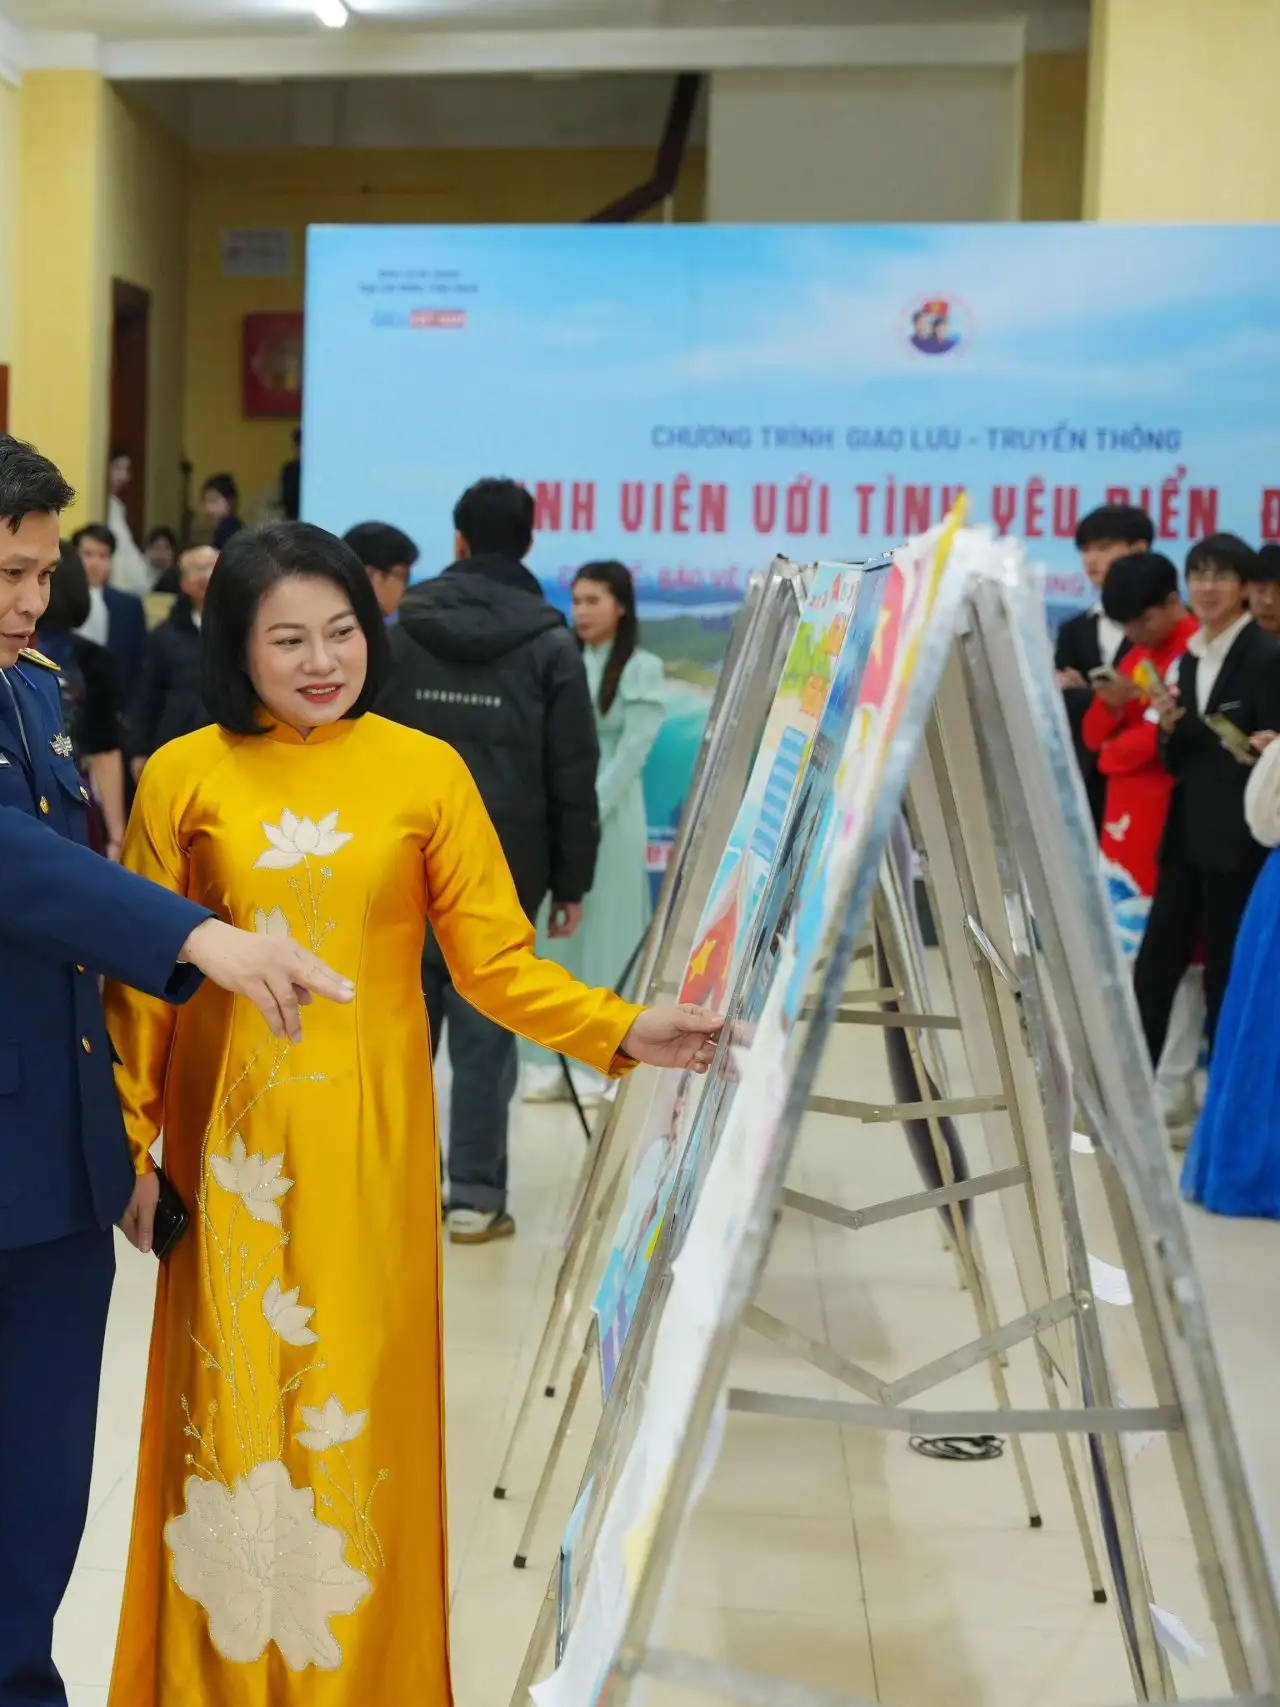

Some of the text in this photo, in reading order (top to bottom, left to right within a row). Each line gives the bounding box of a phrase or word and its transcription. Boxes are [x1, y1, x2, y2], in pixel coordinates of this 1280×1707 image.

[845, 425, 904, 452] GIAO
[1096, 421, 1182, 453] THÔNG
[620, 471, 728, 534] VIÊN
[752, 470, 830, 536] VỚI
[992, 473, 1079, 539] YÊU
